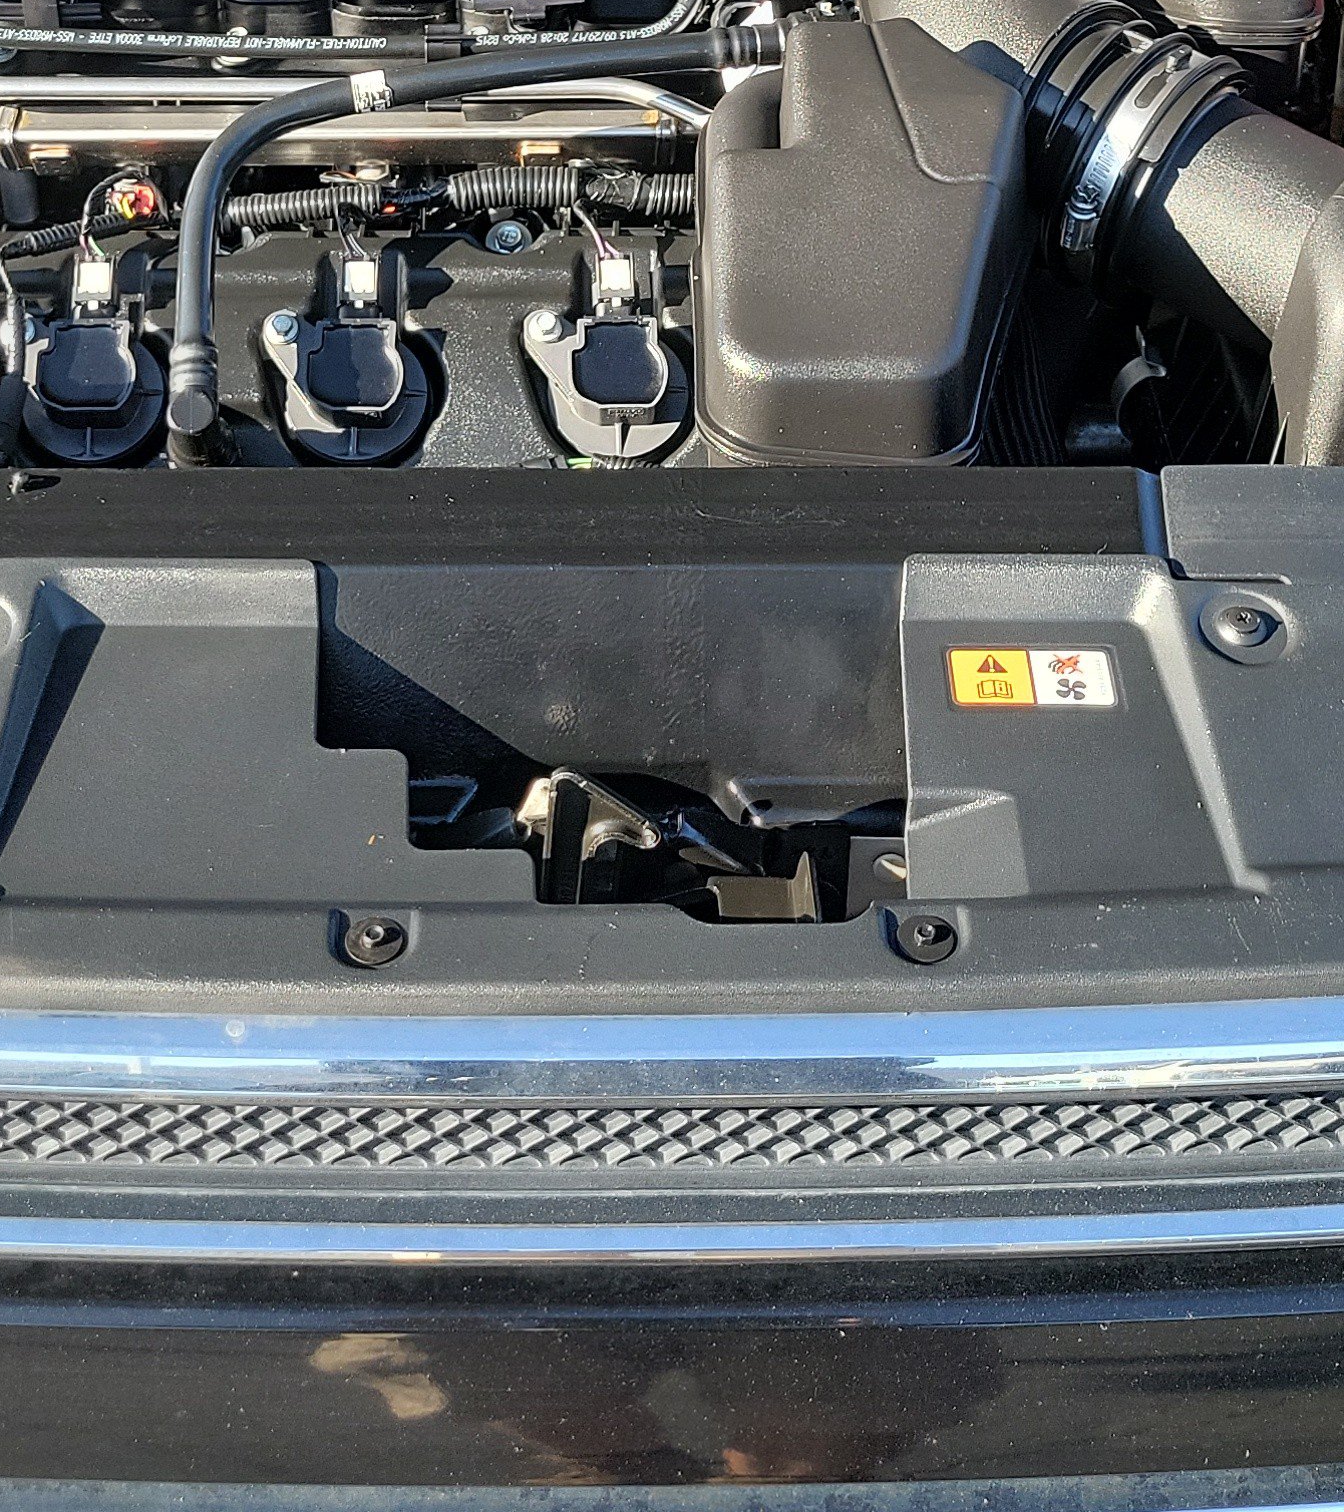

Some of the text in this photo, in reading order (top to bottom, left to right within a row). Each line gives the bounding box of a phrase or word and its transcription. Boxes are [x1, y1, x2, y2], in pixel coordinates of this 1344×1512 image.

[87, 32, 112, 45] ETFE
[115, 32, 145, 45] 3000A
[185, 35, 241, 48] REPAIRABLE
[503, 32, 538, 45] FoMoCo
[540, 31, 570, 44] 20:28
[571, 31, 616, 44] 09/29/17
